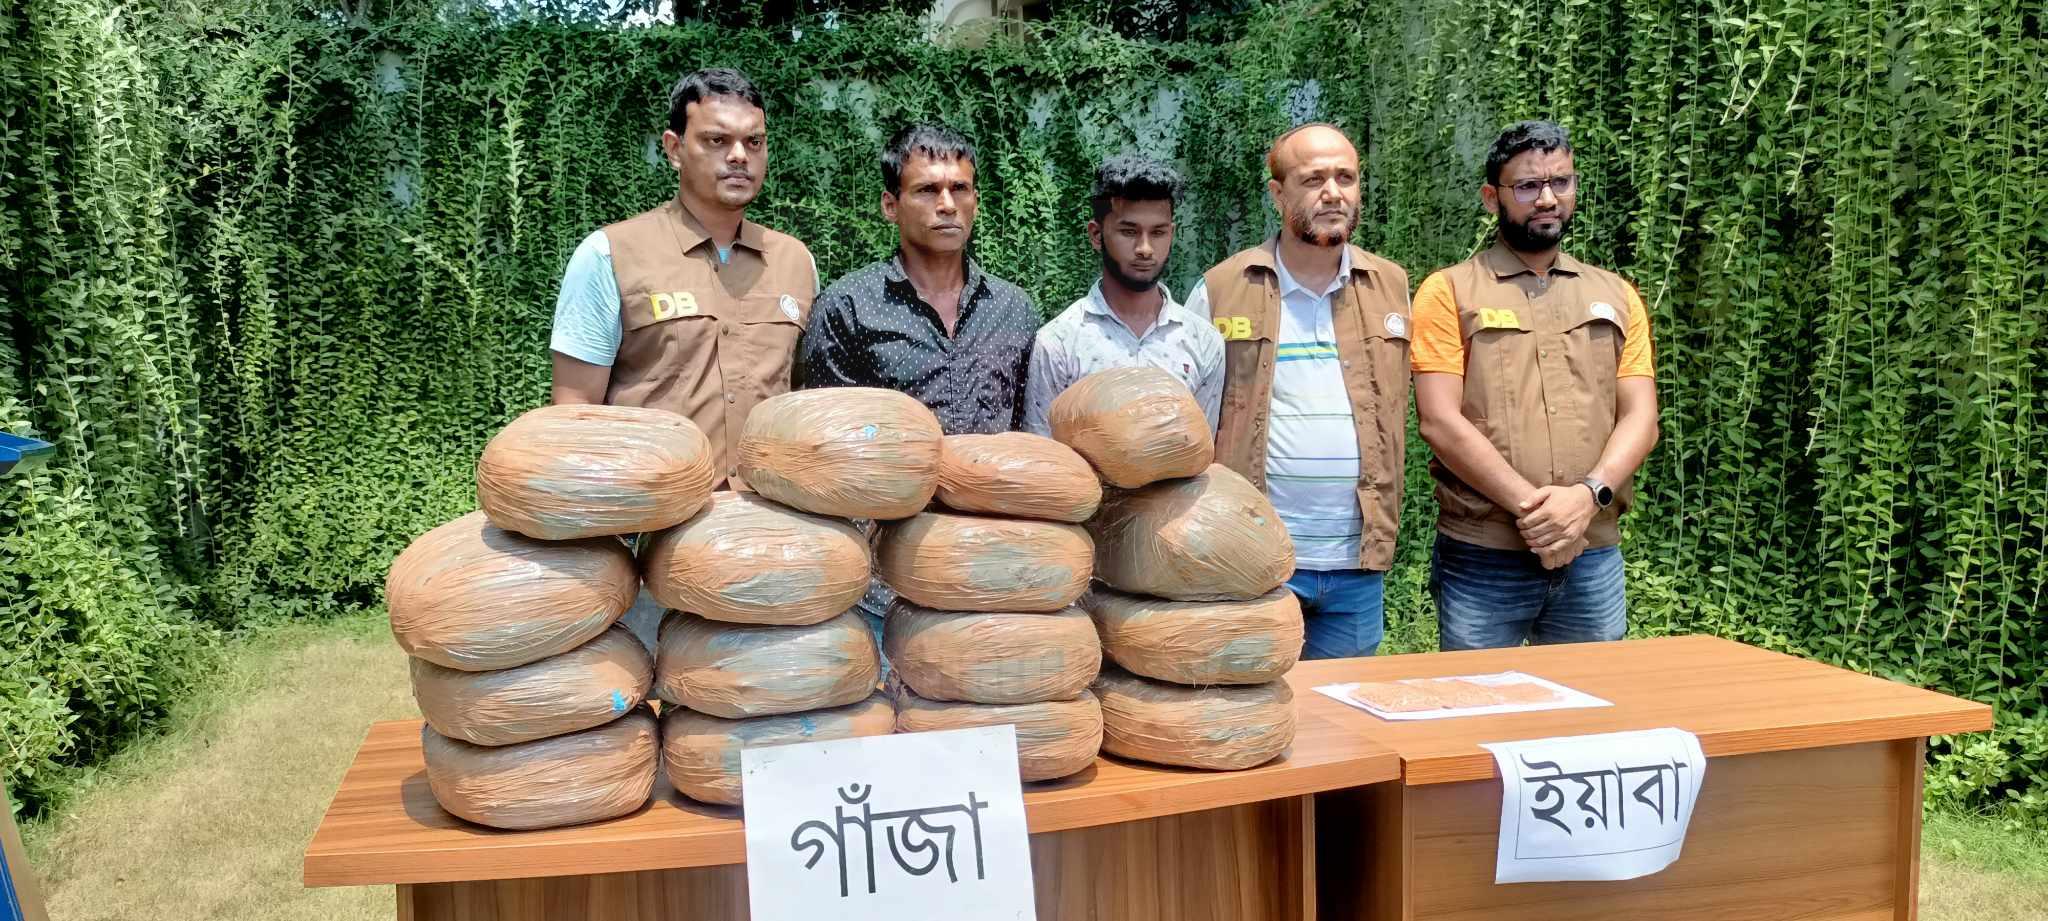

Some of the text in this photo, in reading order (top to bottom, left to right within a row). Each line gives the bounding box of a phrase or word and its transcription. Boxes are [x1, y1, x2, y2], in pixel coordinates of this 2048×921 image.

[650, 291, 699, 321] DB
[1479, 307, 1520, 330] DB
[1213, 315, 1253, 340] DB
[1520, 753, 1689, 837] ইয়াবা
[790, 782, 989, 898] গাঁজা
